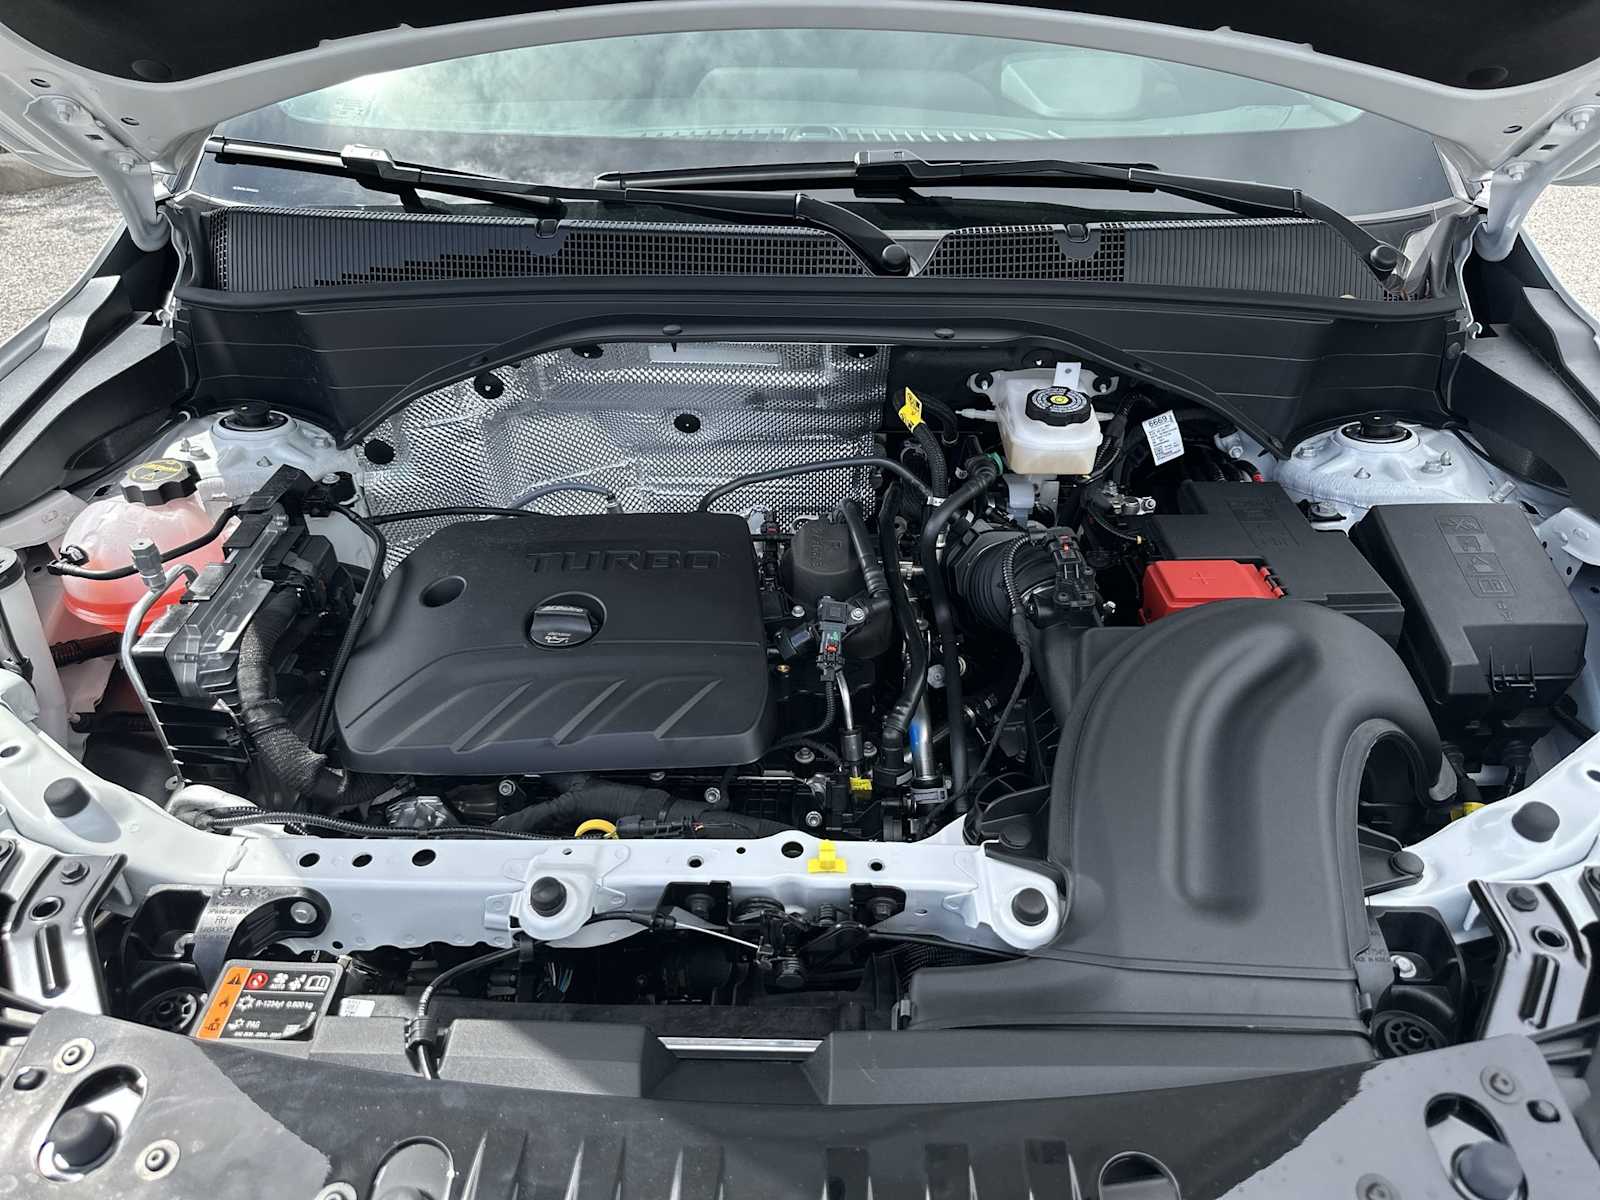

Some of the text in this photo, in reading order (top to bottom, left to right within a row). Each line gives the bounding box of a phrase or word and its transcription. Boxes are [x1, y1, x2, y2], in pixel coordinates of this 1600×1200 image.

[1148, 415, 1168, 427] 6669
[527, 550, 720, 573] TURBO
[246, 1020, 261, 1028] PAG
